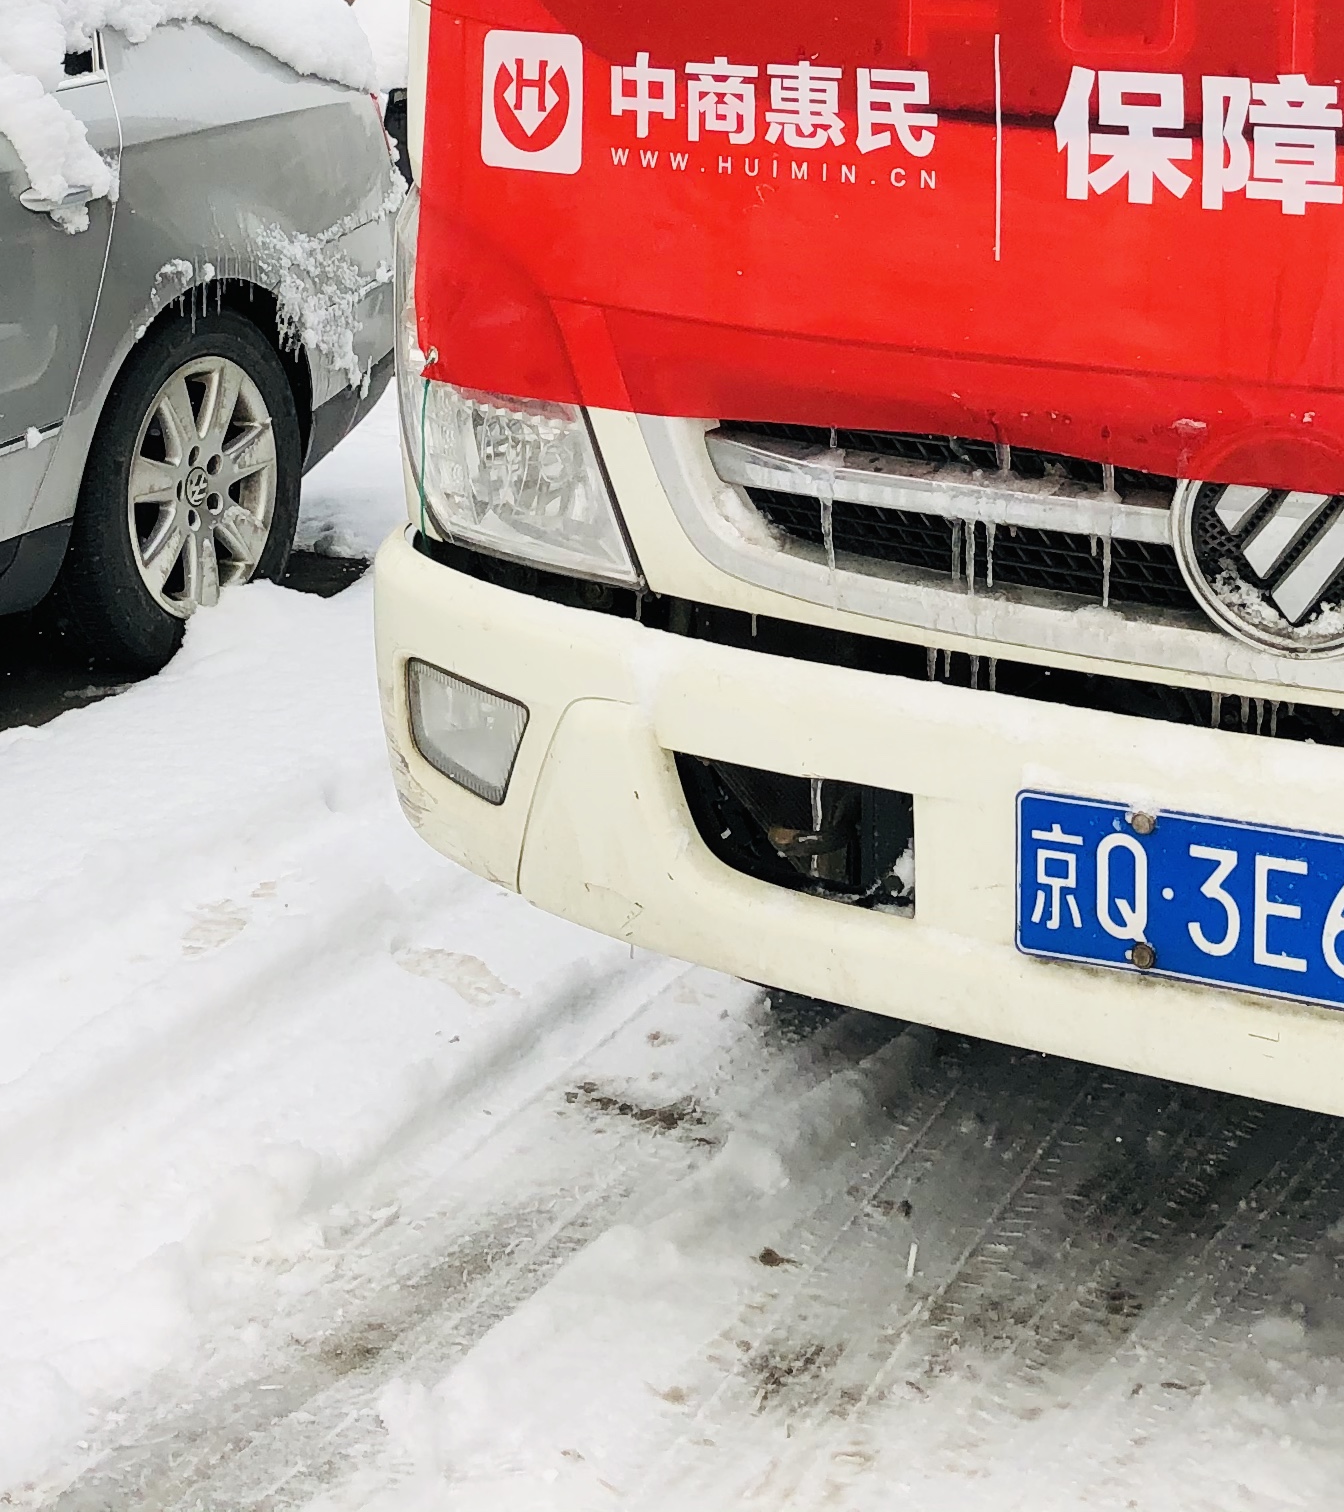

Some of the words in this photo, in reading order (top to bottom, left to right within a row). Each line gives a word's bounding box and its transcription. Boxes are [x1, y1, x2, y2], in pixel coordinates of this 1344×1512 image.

[610, 51, 938, 158] 中商惠民
[611, 146, 938, 190] WWW.HUIMIN.CN
